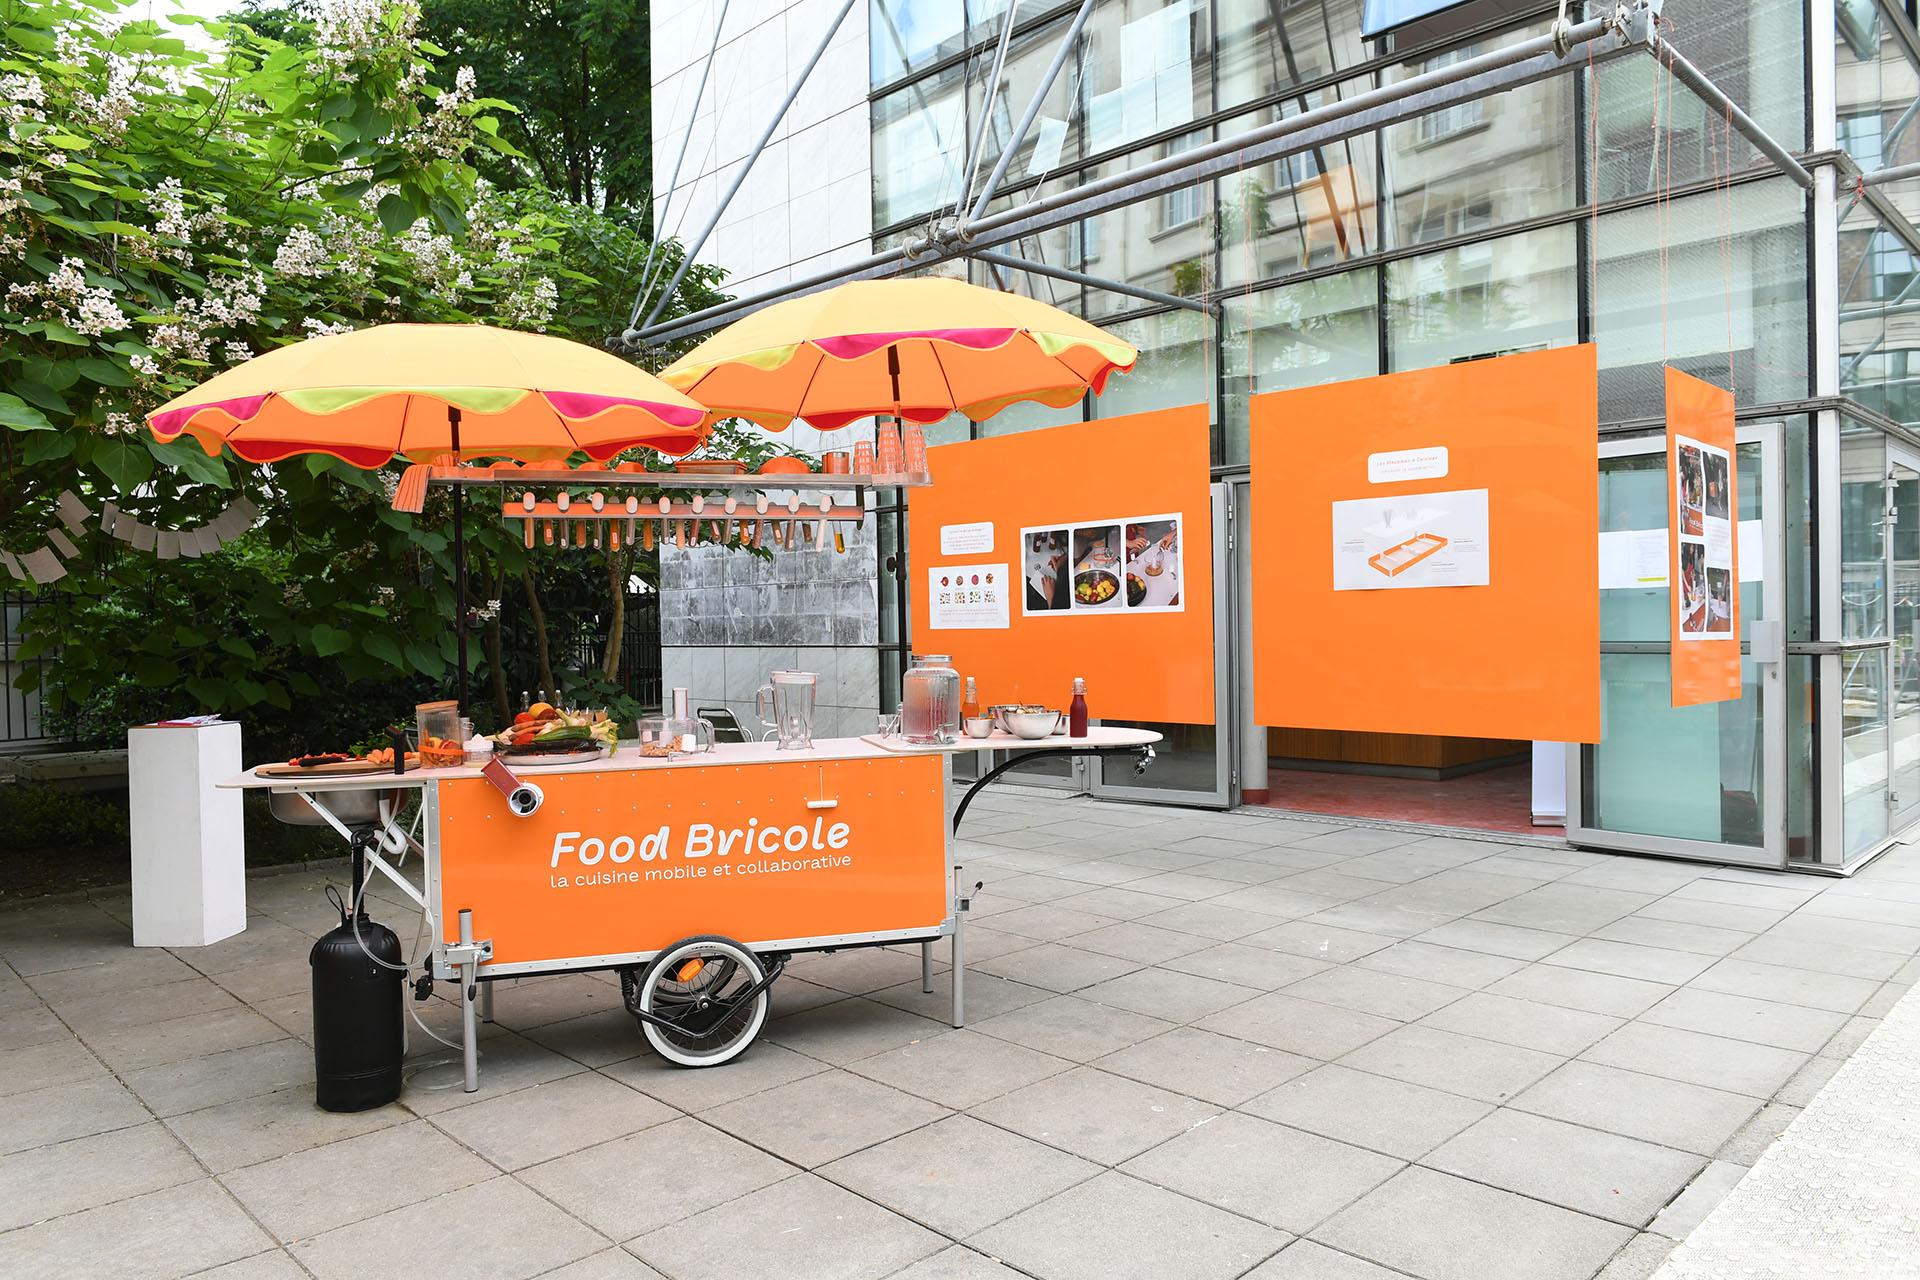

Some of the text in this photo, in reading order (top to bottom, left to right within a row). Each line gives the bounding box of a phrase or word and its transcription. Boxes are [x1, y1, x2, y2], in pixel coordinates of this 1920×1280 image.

[550, 815, 851, 868] Food Bricole
[550, 854, 852, 888] la cuisine mobile et collaborative
